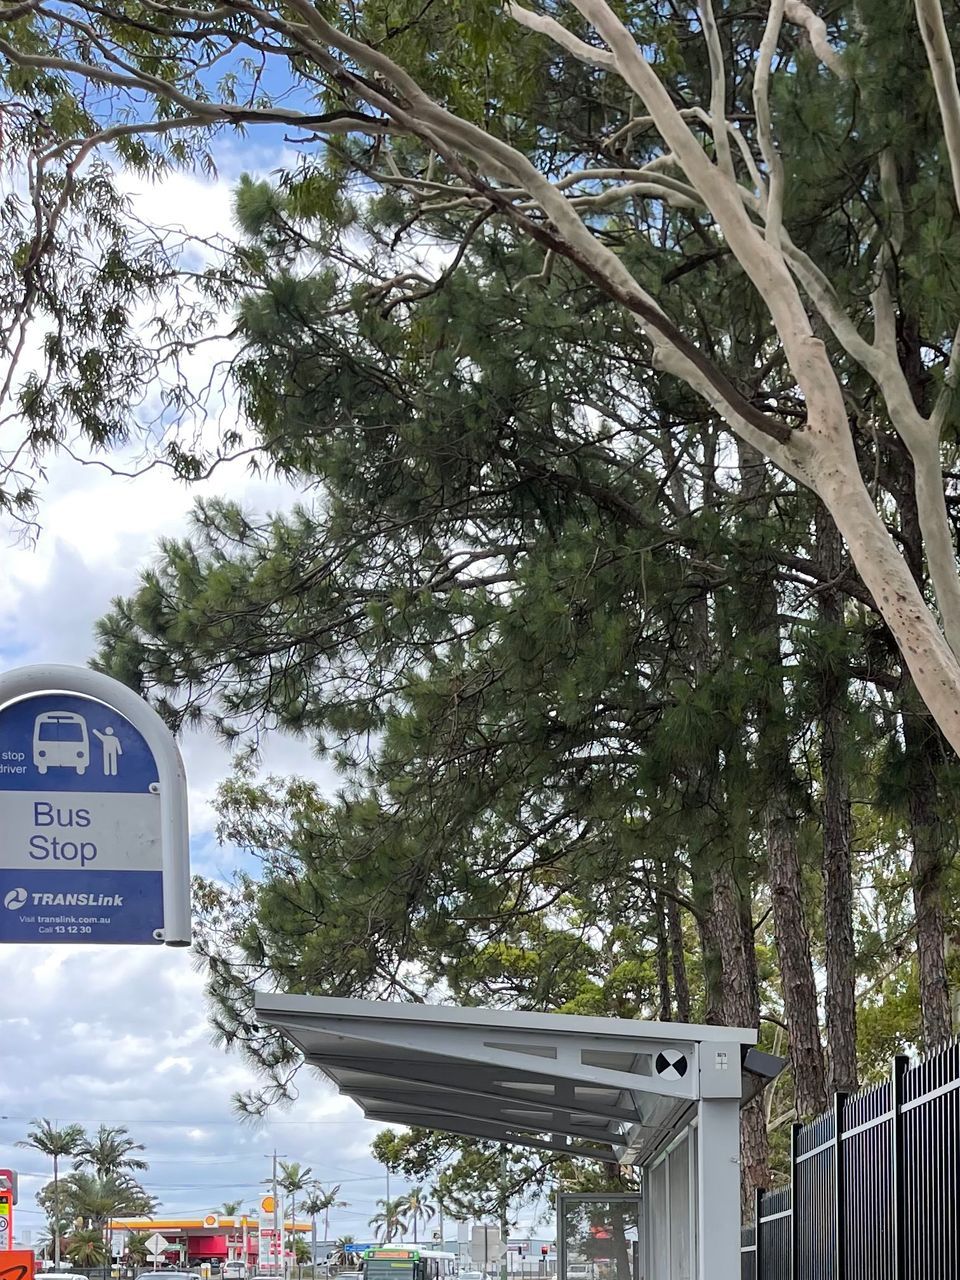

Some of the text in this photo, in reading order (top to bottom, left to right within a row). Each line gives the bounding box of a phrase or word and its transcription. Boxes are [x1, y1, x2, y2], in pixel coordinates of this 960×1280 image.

[2, 751, 25, 762] stop
[33, 801, 91, 828] Bus
[29, 834, 98, 867] Stop
[19, 915, 111, 924] Visit translink.com.au
[38, 926, 92, 934] Call 13 12 30
